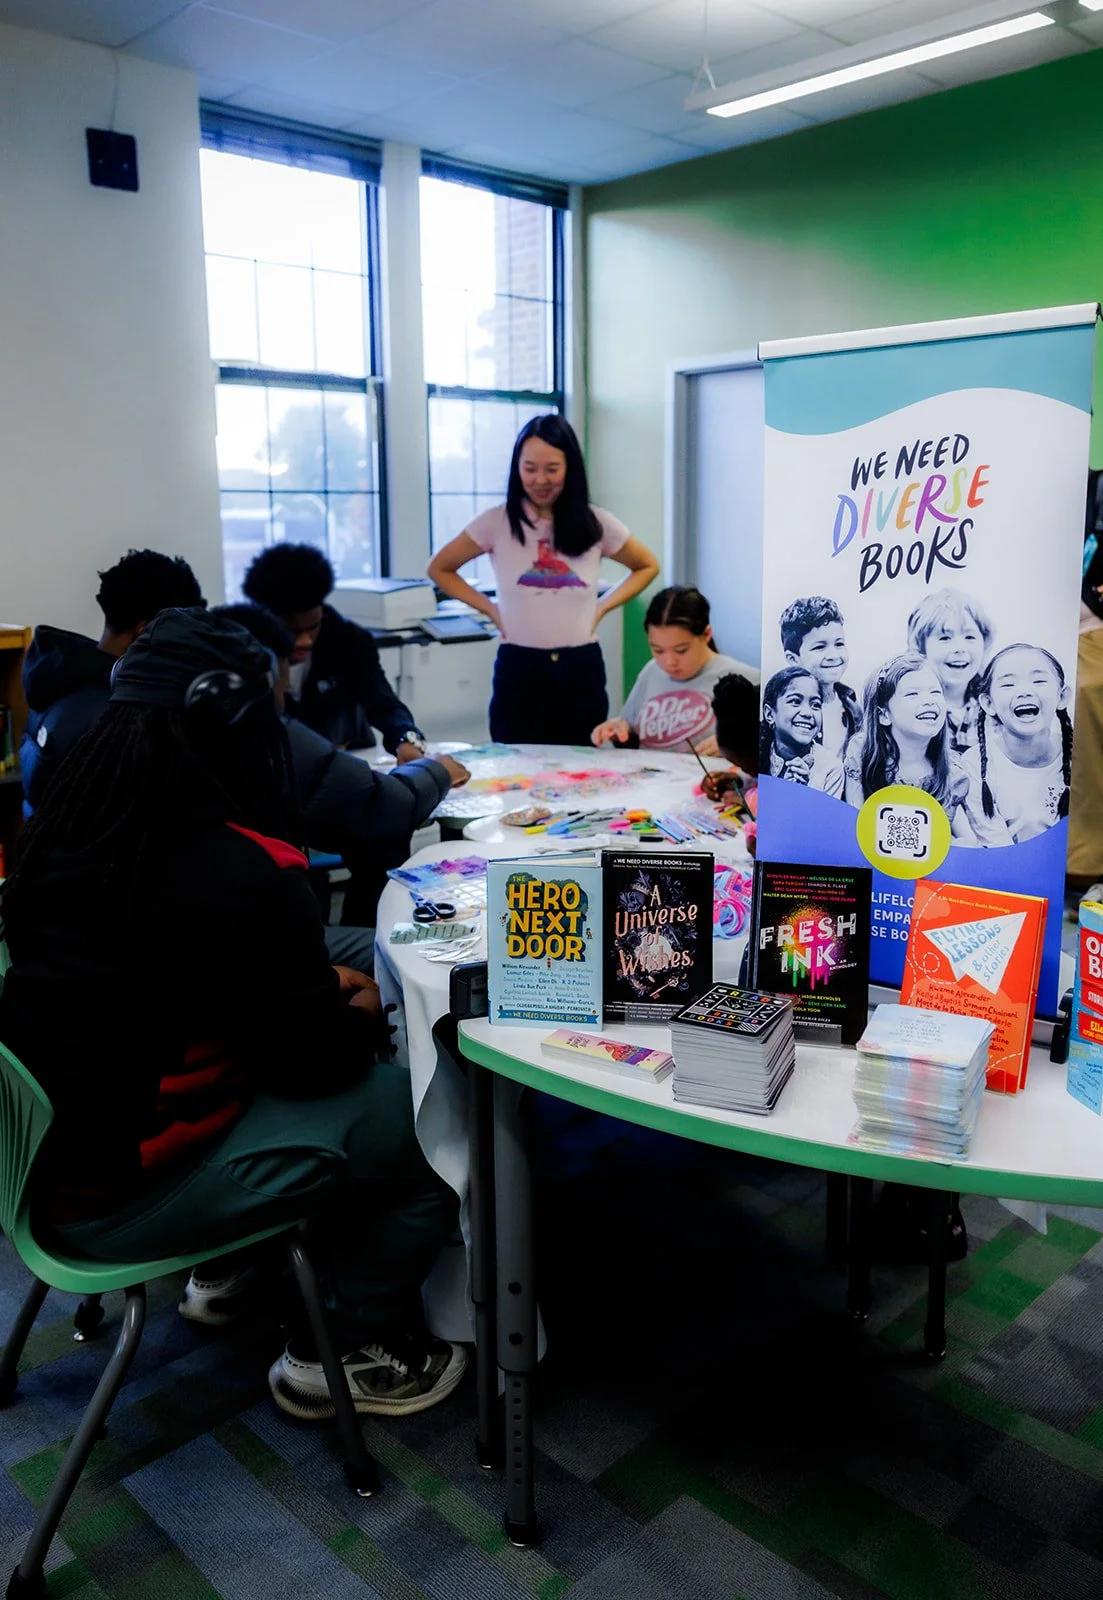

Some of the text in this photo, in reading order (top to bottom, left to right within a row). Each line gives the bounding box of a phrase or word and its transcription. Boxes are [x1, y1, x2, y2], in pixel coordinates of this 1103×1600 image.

[851, 433, 970, 491] WE NEED
[832, 465, 990, 558] DIVERSE
[859, 518, 974, 593] BOOKS
[640, 700, 707, 740] Pepper
[661, 696, 690, 718] Dr
[508, 881, 580, 910] HERO
[650, 884, 662, 906] A
[510, 910, 582, 934] NEXT
[615, 904, 698, 937] Universe
[988, 905, 1010, 914] Anthology
[645, 926, 662, 946] of
[760, 912, 857, 950] FRESH
[930, 922, 986, 945] FLYING
[944, 924, 1002, 963] LESSONS
[508, 934, 583, 960] DOOR
[781, 943, 836, 973] INK
[972, 940, 1000, 972] & other
[618, 946, 690, 976] Wishes
[830, 962, 857, 971] ANTHOLOGY
[984, 946, 1010, 982] stories
[730, 990, 770, 1002] READ
[916, 989, 934, 1000] Kelly
[964, 999, 988, 1011] Soman
[988, 1006, 1018, 1018] Chainani
[929, 984, 992, 1002] Kwame Alexander
[689, 1014, 733, 1026] BOOKS
[714, 1011, 758, 1024] BANNED
[916, 998, 933, 1008] Matt
[950, 1006, 967, 1016] Peña
